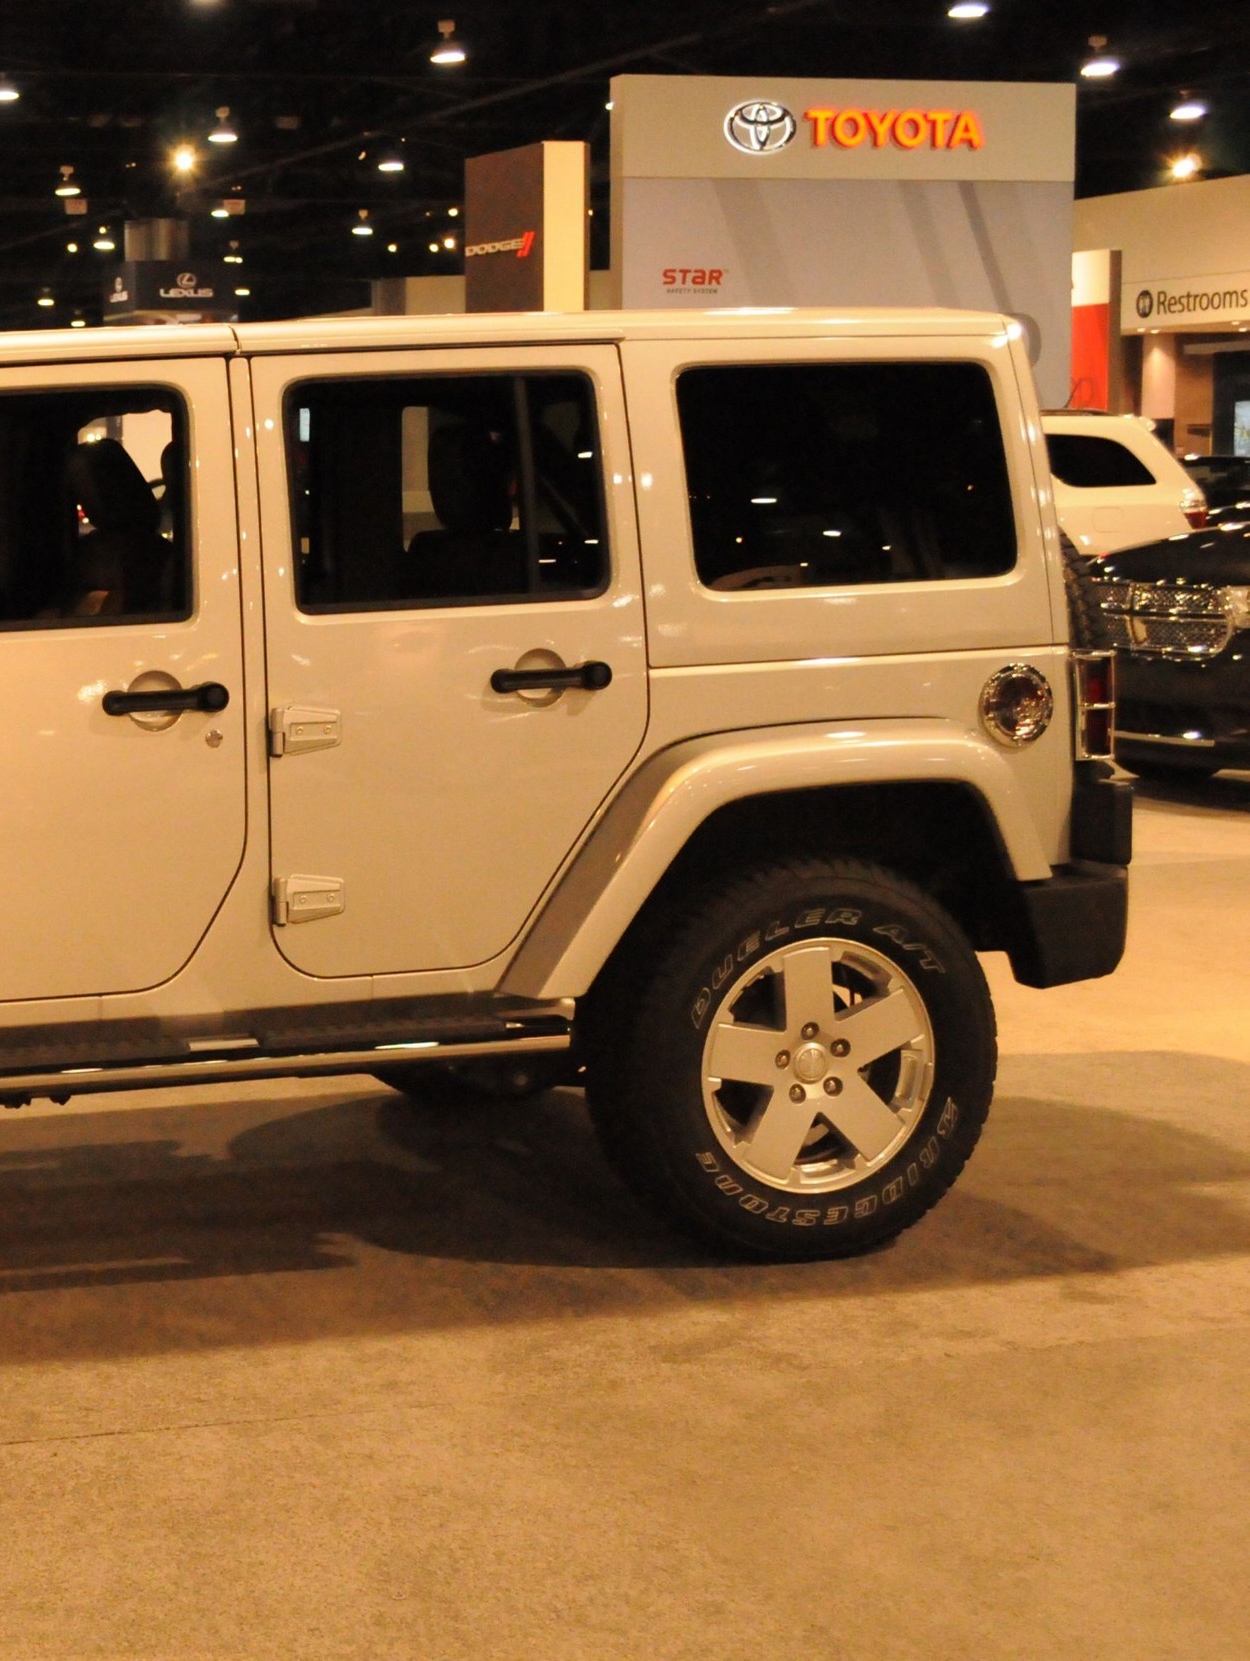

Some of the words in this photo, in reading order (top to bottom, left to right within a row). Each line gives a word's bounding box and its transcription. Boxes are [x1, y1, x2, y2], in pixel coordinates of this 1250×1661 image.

[804, 107, 985, 150] TOYOTA
[465, 238, 525, 257] DODGE
[159, 288, 214, 298] LEXUS
[1156, 288, 1249, 315] Restrooms
[689, 907, 863, 1030] DUELER
[872, 924, 946, 975] A/T
[695, 1096, 959, 1227] BRIDGESTONE
